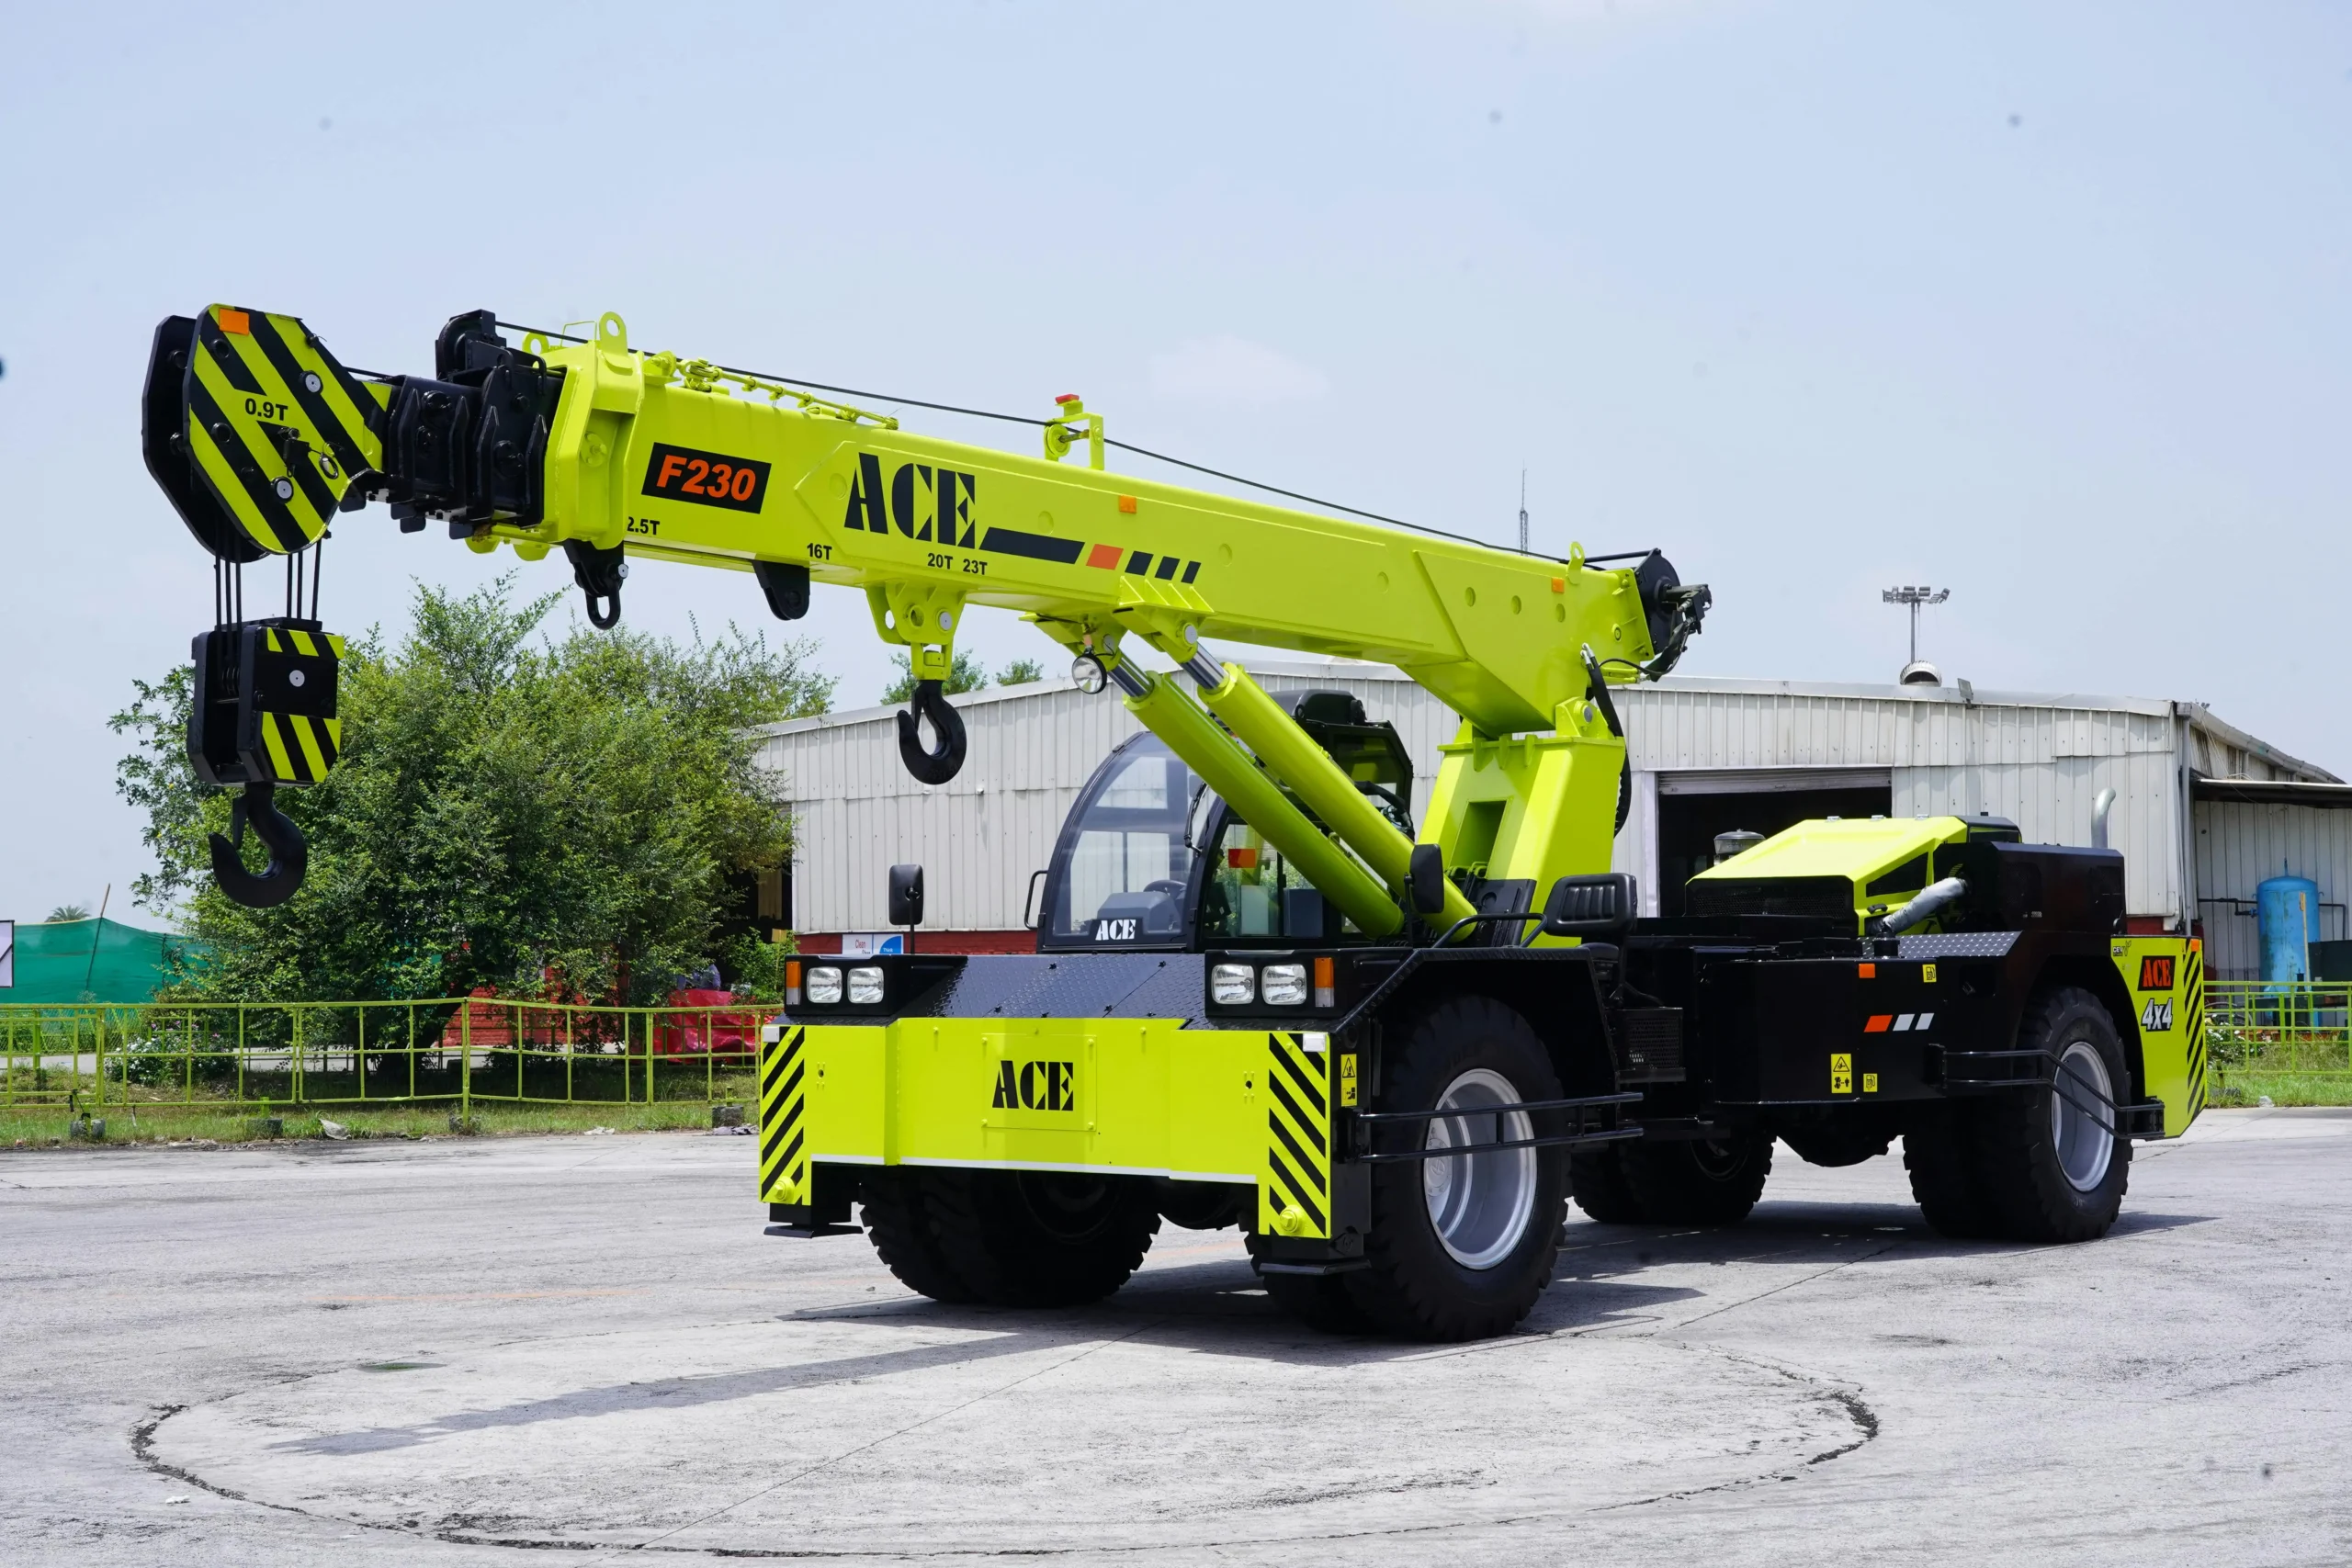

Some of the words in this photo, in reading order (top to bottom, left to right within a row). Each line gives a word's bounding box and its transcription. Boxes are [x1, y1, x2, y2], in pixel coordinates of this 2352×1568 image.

[244, 398, 288, 421] 0.9T
[656, 455, 756, 502] F230
[843, 452, 976, 549] ACE
[807, 543, 832, 560] 16T
[927, 552, 954, 570] 20T
[962, 558, 988, 576] 23T
[1095, 919, 1136, 941] ACE
[2142, 959, 2172, 987] ACE
[2142, 998, 2173, 1030] 4x4
[991, 1060, 1074, 1111] ACE
